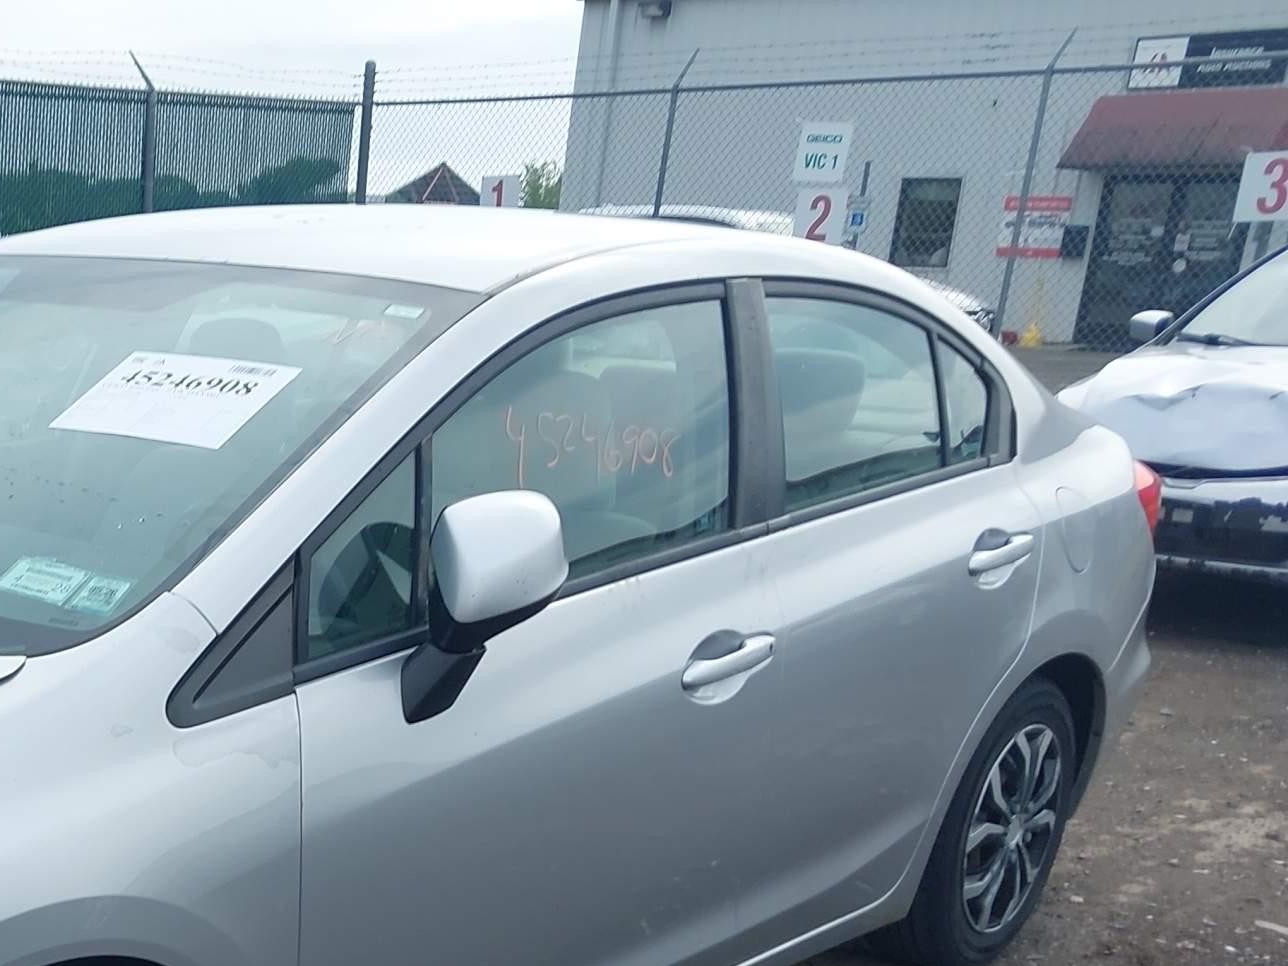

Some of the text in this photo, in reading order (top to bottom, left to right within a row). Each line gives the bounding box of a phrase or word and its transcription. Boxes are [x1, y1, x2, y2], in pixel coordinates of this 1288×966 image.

[804, 152, 839, 170] VIC 1
[491, 179, 504, 208] 1
[1256, 157, 1288, 215] 3
[804, 194, 832, 243] 2
[120, 368, 260, 396] 45246908
[504, 403, 680, 491] 45246908
